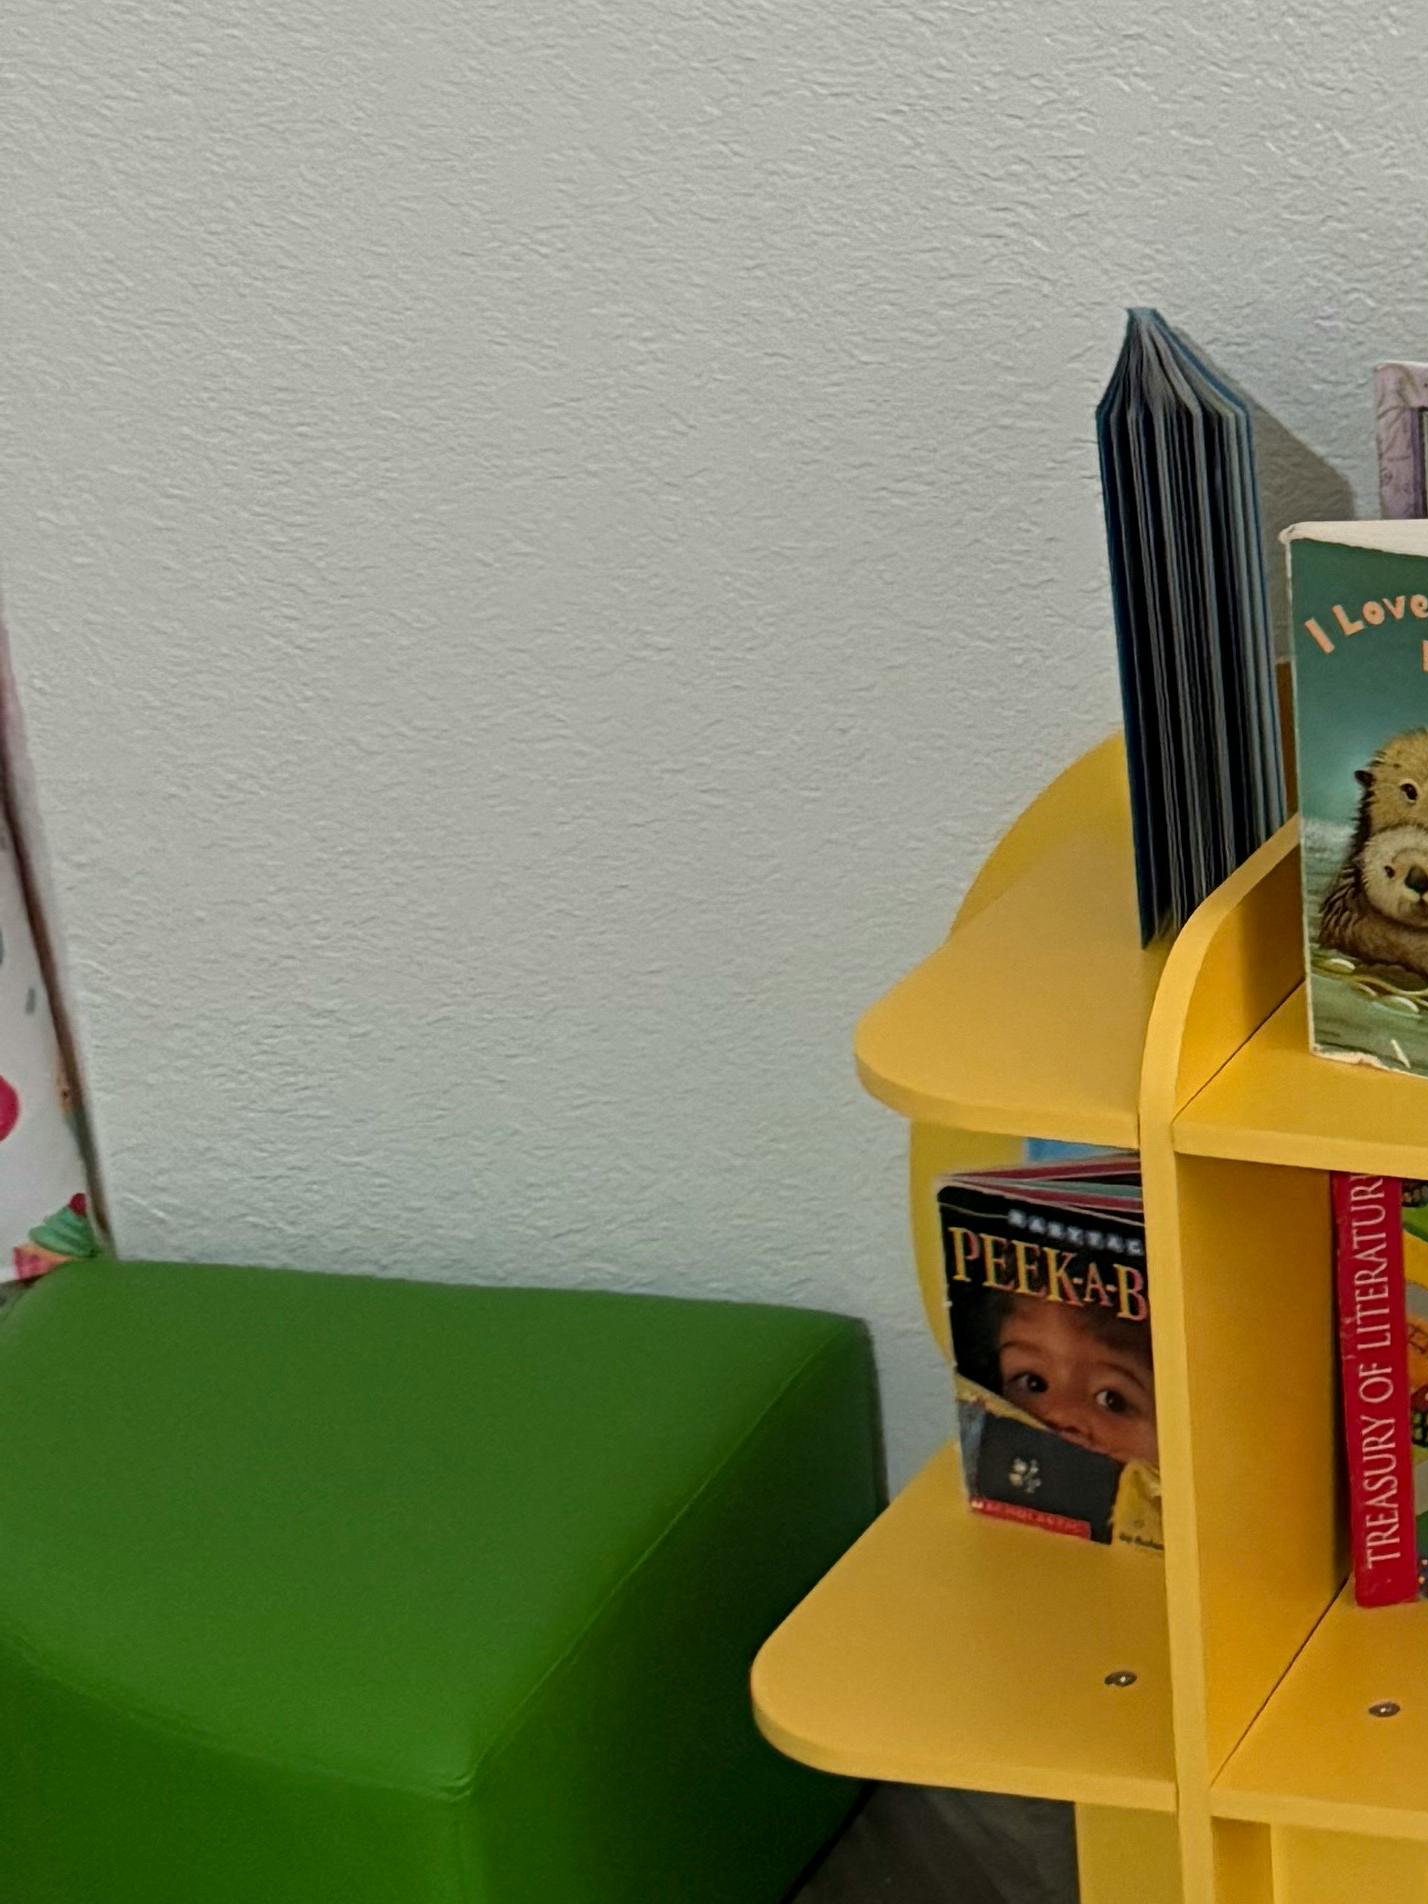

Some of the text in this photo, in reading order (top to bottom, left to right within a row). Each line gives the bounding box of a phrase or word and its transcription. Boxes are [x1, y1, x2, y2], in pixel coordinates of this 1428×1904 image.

[1305, 617, 1335, 655] I
[1351, 1175, 1401, 1569] TREASURY OF LITERATUR
